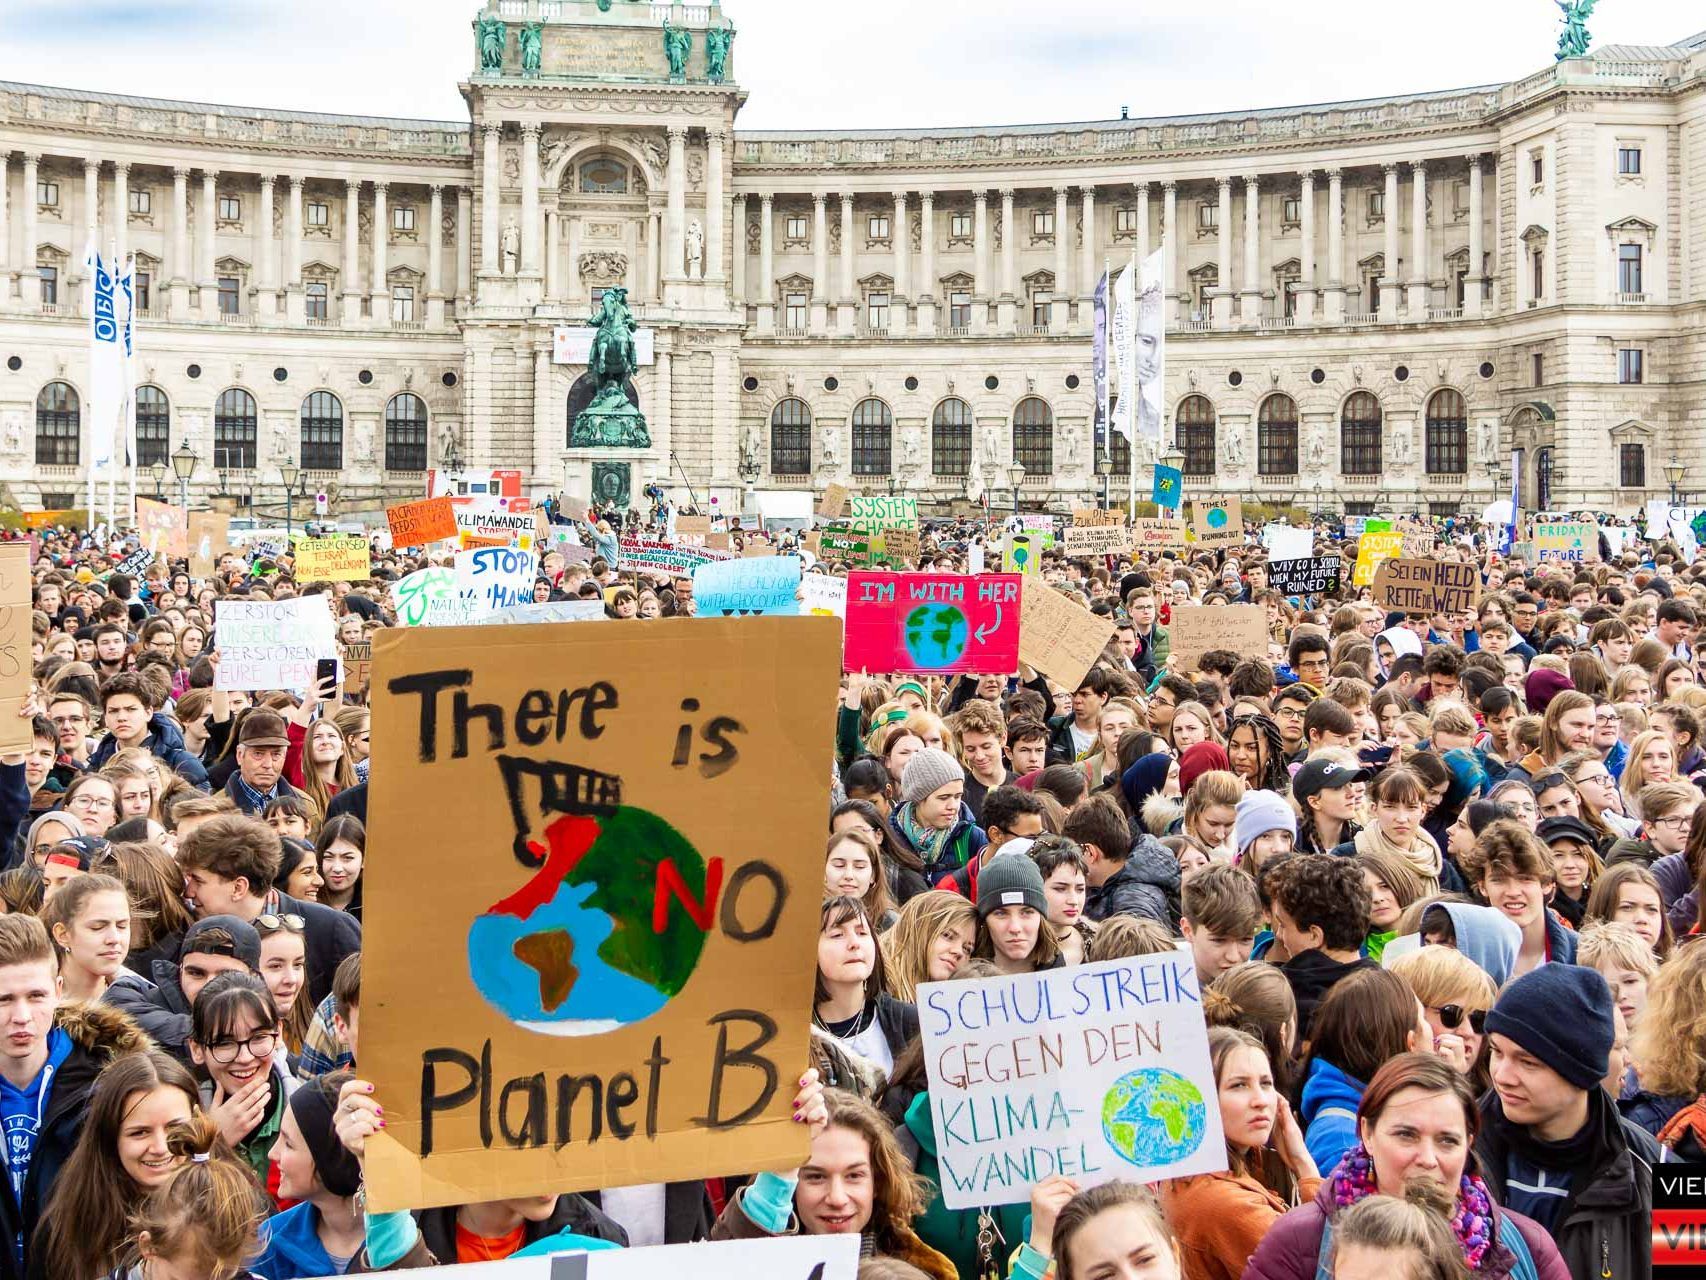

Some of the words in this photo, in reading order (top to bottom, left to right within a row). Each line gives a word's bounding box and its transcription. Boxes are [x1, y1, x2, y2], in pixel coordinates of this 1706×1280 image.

[852, 497, 917, 519] SYSTEM
[1200, 501, 1219, 509] TIME
[457, 513, 536, 530] KLIMAWANDEL
[1074, 516, 1119, 528] ZUKUNFT
[1201, 532, 1227, 541] RUNNING
[1228, 530, 1239, 539] OUT
[1539, 525, 1593, 537] FRIDAYS
[299, 541, 335, 551] CETERUM
[336, 540, 366, 551] CENSEO
[832, 539, 858, 549] NOT
[314, 550, 348, 561] TERRAM
[313, 566, 331, 577] ESSE
[331, 559, 367, 570] DELENDAM
[654, 562, 685, 573] COLBERT
[1271, 560, 1295, 572] WHY
[1296, 559, 1308, 570] GO
[1318, 557, 1341, 569] SCHOOL
[1269, 572, 1289, 584] WHEN
[1293, 571, 1309, 581] MY
[1310, 568, 1337, 579] FUTURE
[1413, 566, 1431, 582] EIN
[1434, 563, 1475, 588] HELD
[859, 581, 896, 602] I'M
[909, 582, 965, 601] WITH
[978, 581, 1018, 602] HER
[1287, 579, 1326, 593] RUINED
[430, 599, 478, 612] NATURE
[699, 594, 726, 609] WITH
[730, 593, 791, 609] CHOCOLATE
[1386, 585, 1424, 608] RETTE
[1422, 593, 1433, 610] DIE
[1432, 586, 1475, 614] WELT
[219, 663, 262, 684] EURE
[387, 667, 620, 765] There
[671, 696, 748, 779] is
[652, 855, 791, 944] NO
[927, 961, 1199, 1036] SCHULSTREIK
[938, 1032, 1064, 1090] GEGEN
[1083, 1019, 1163, 1066] DEN
[420, 1034, 671, 1159] Planet
[693, 1009, 780, 1130] B
[939, 1090, 1085, 1147] KLIMA-
[941, 1142, 1102, 1192] WANDEL
